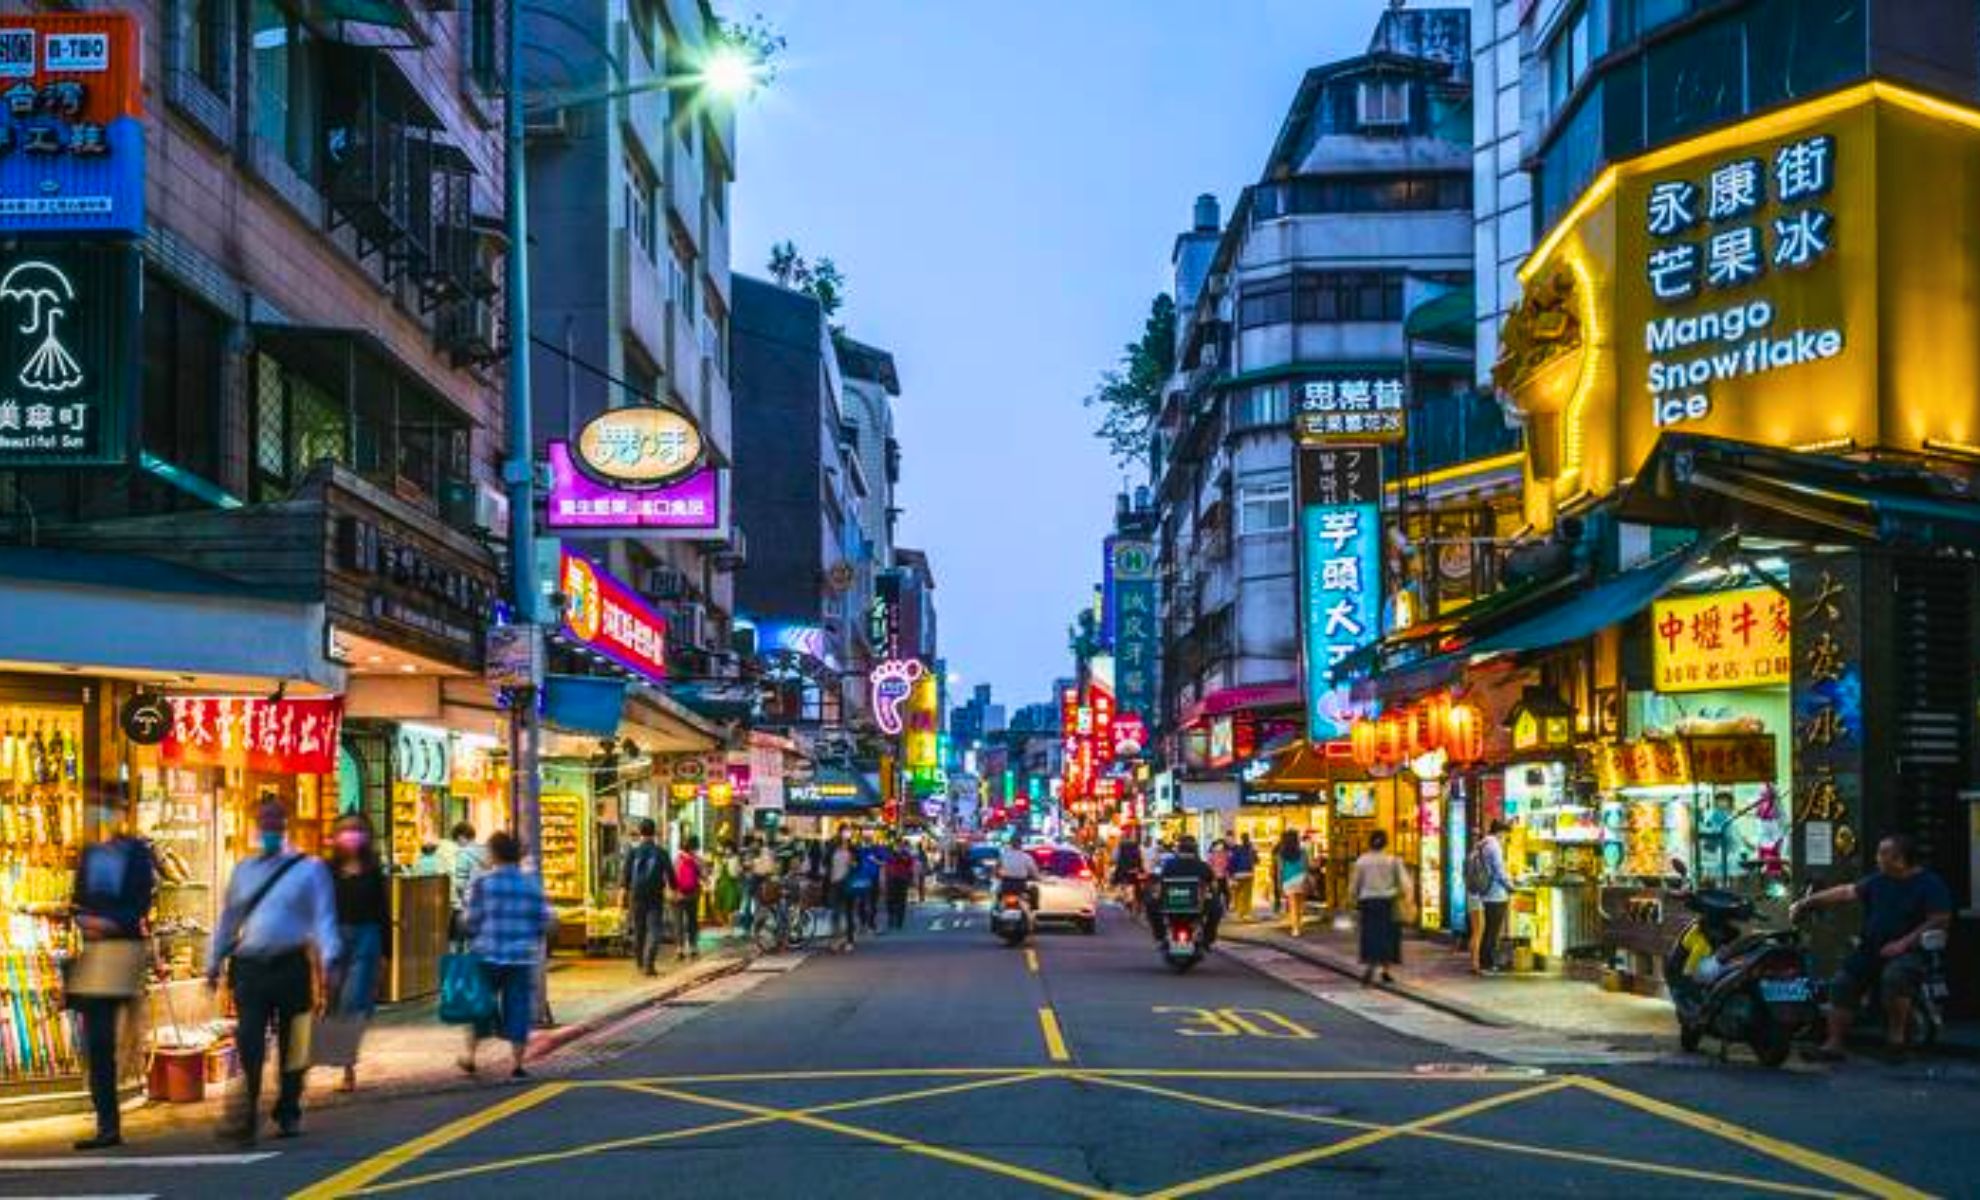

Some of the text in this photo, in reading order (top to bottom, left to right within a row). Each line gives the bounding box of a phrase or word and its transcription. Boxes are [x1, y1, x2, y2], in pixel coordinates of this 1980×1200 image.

[1647, 136, 1831, 234] 永康街
[1649, 211, 1830, 298] 芒果冰
[1645, 301, 1771, 351] Mango
[1647, 328, 1842, 391] Snowflake
[1653, 394, 1708, 427] Ice
[1151, 1006, 1320, 1039] 30
